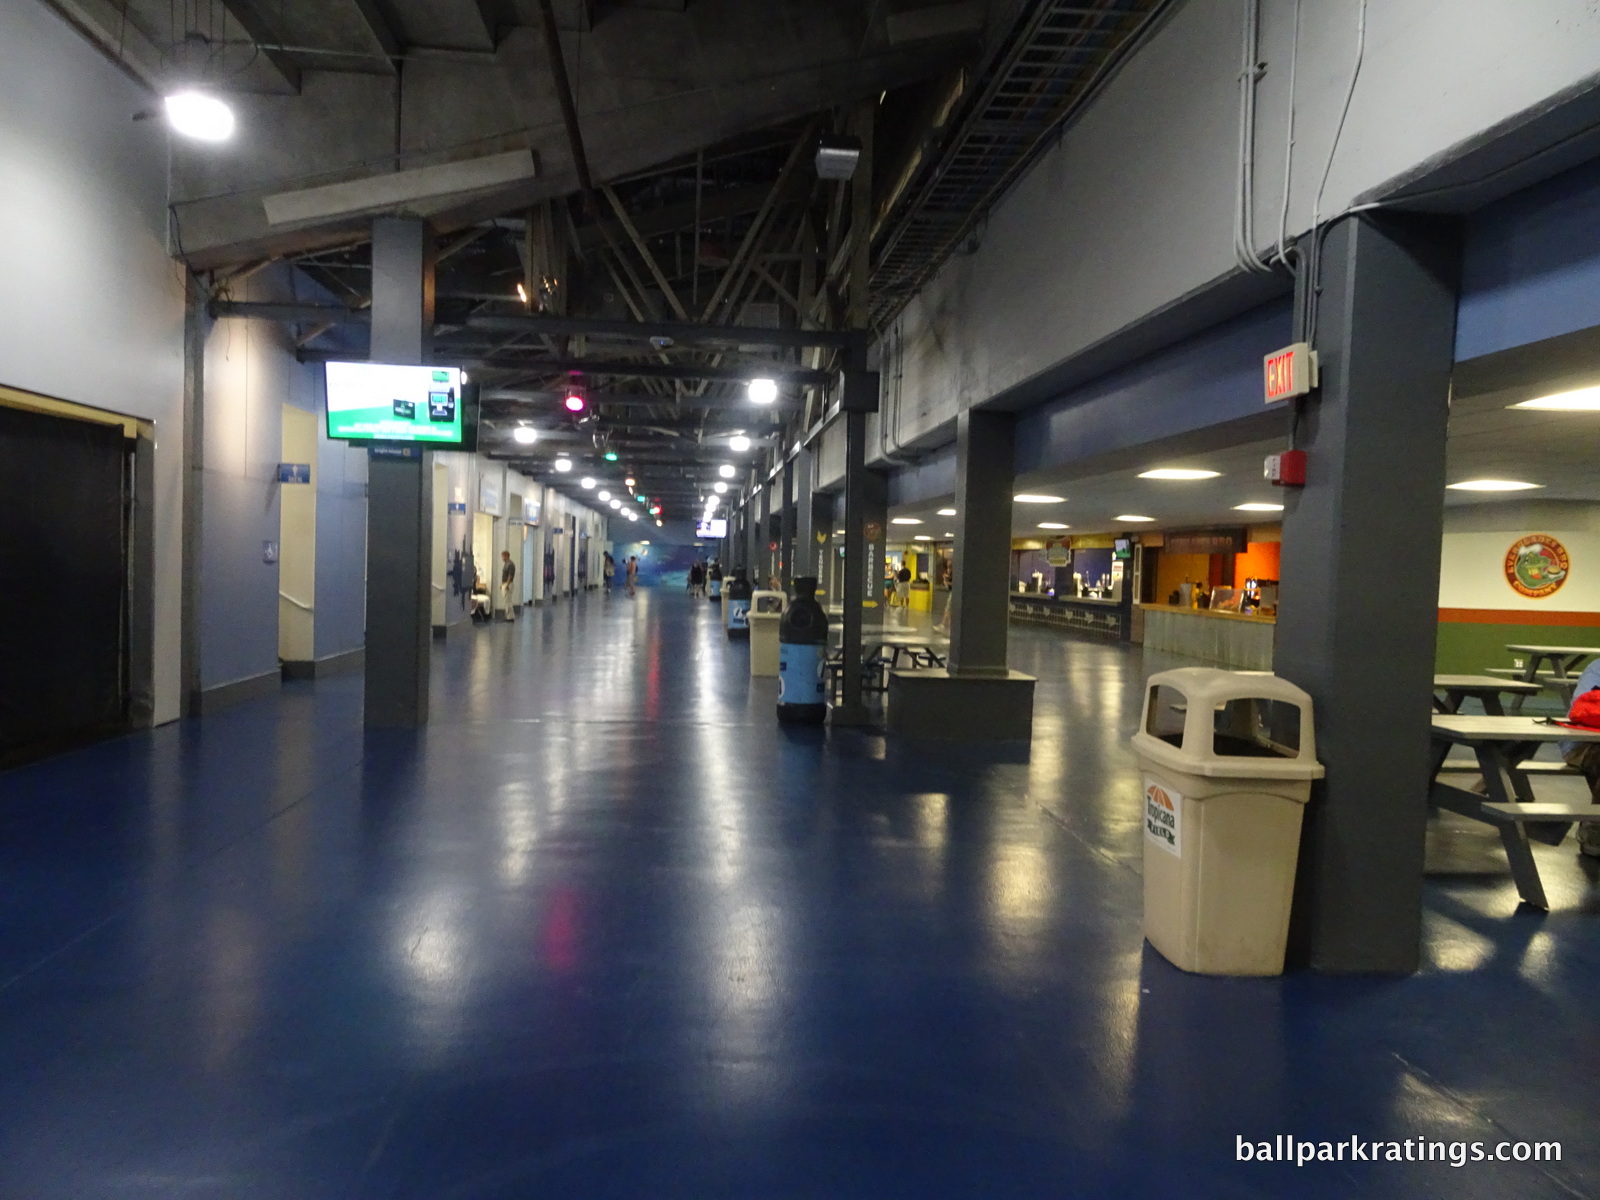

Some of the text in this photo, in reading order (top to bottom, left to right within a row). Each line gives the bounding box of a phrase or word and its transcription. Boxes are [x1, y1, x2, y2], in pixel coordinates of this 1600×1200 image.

[1267, 351, 1295, 398] EXIT
[866, 543, 874, 597] BARBECUE
[1556, 547, 1568, 570] BBQ
[1513, 580, 1557, 597] COMPANY
[1147, 794, 1175, 829] Tropicana
